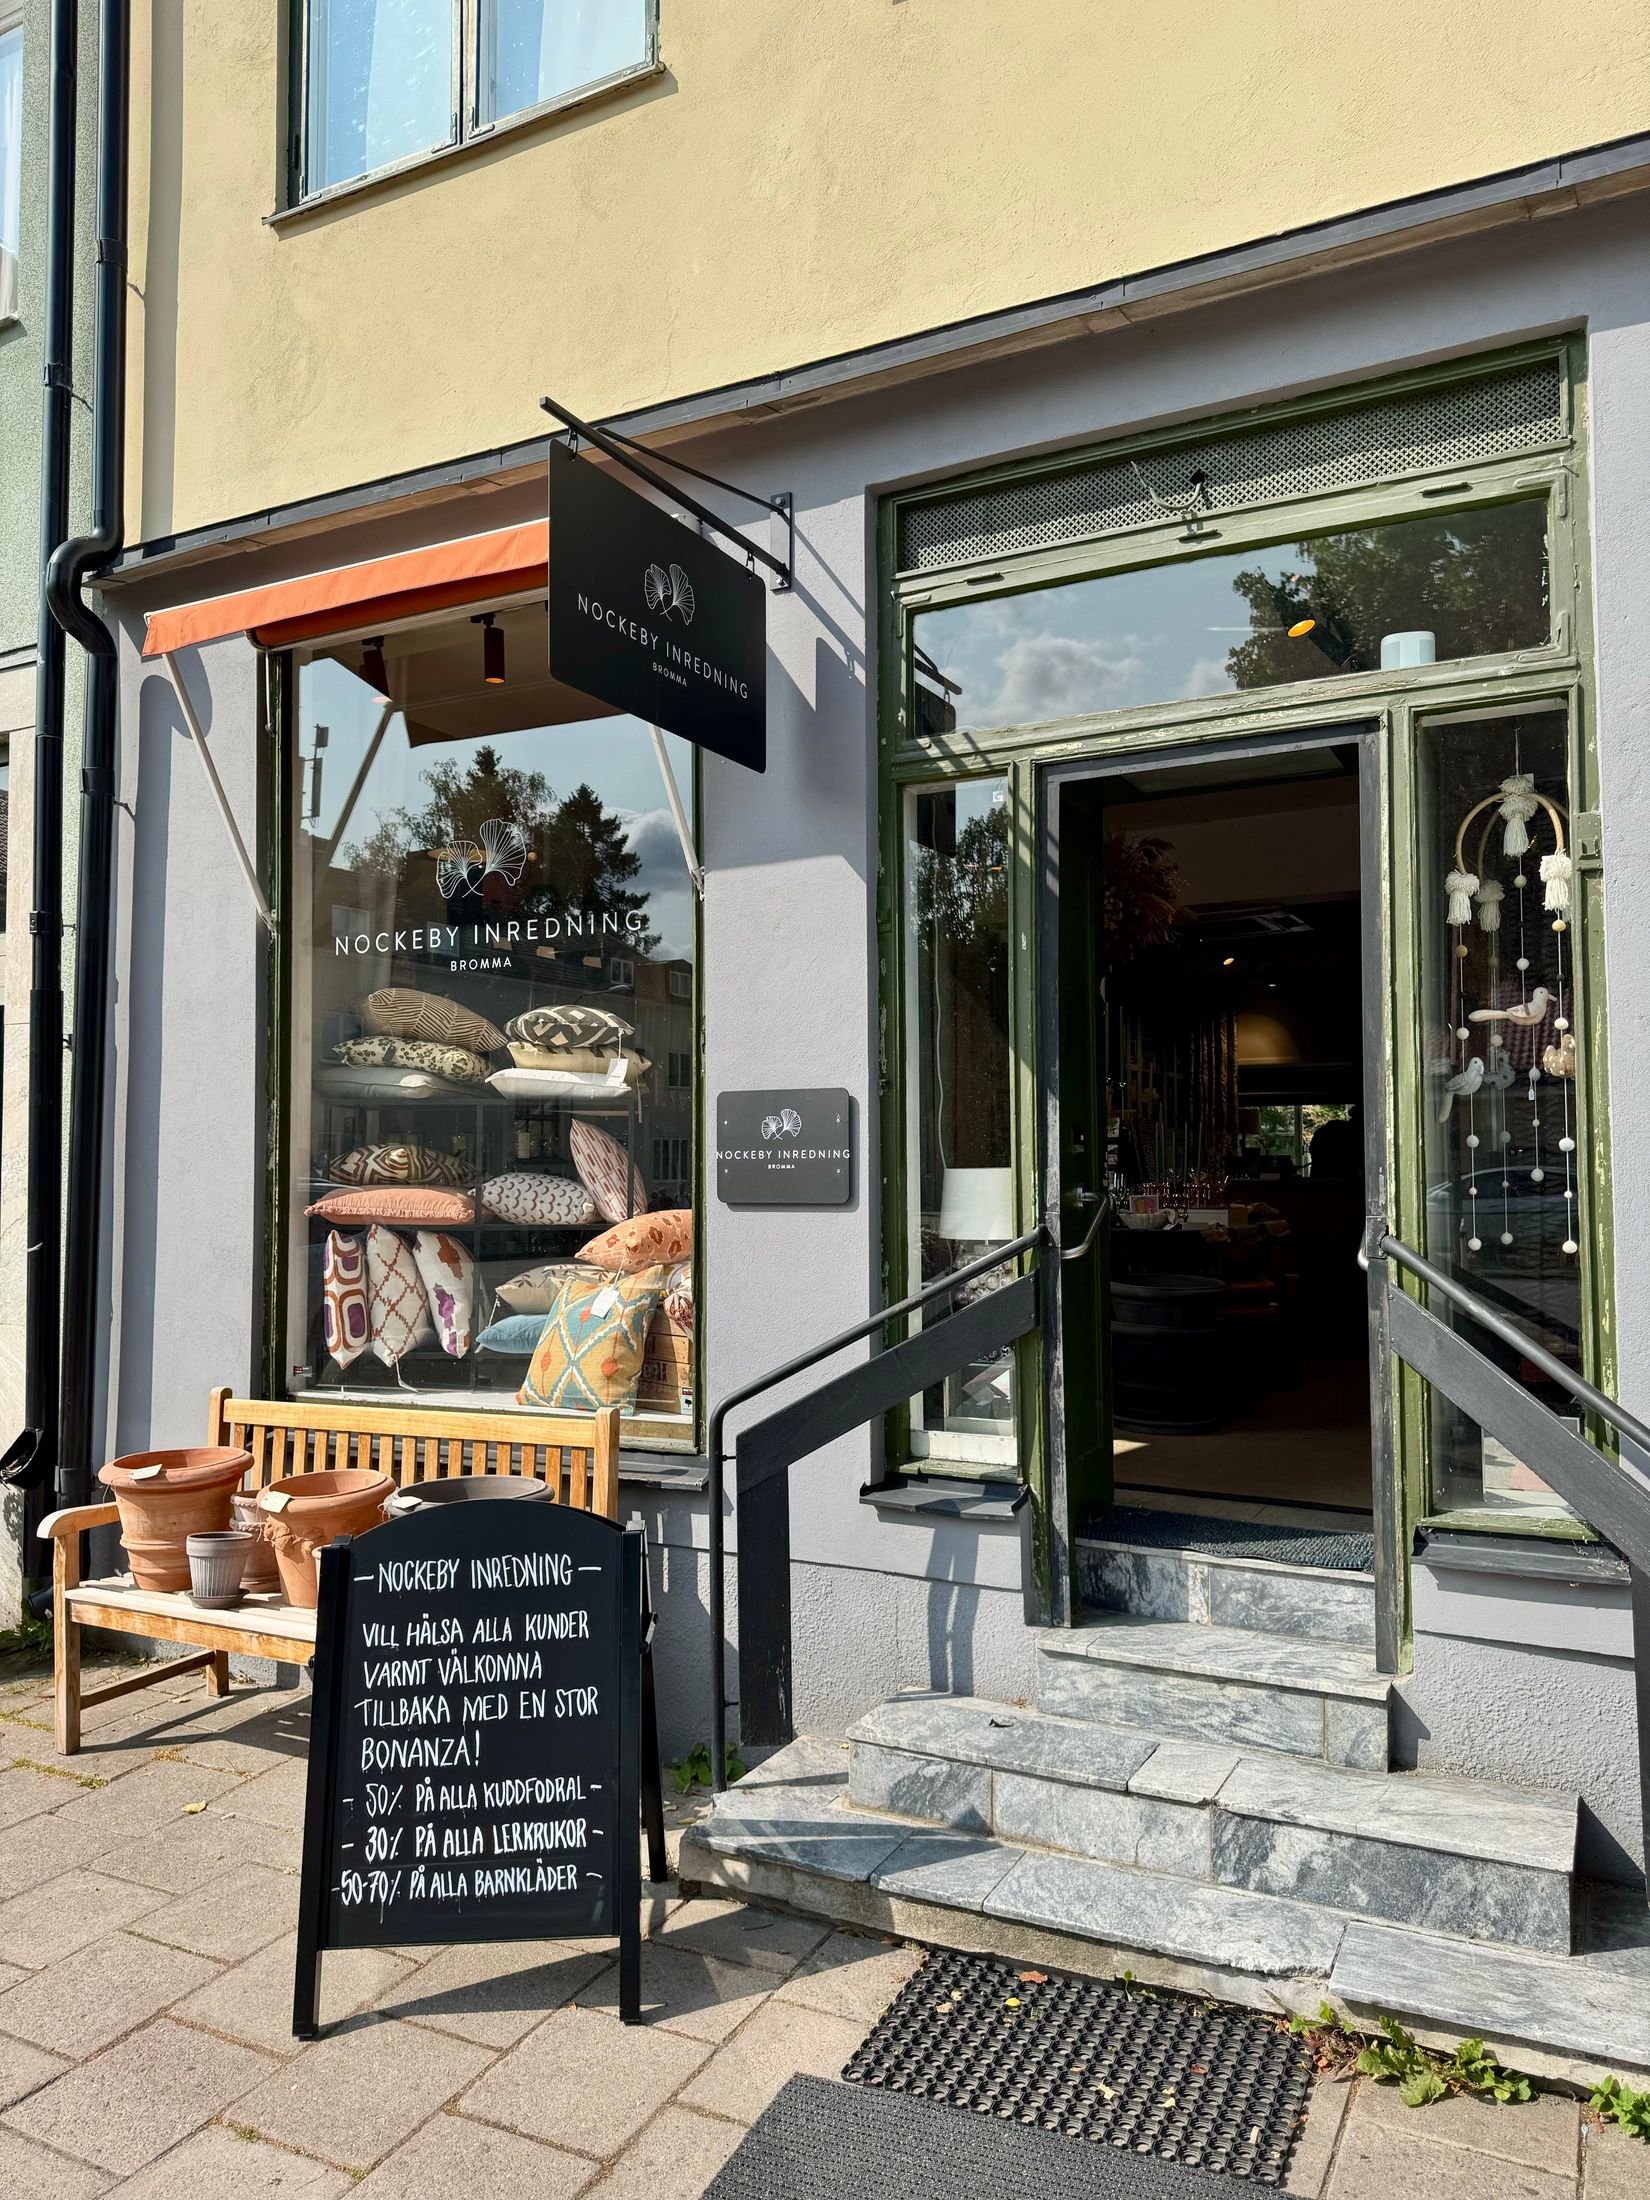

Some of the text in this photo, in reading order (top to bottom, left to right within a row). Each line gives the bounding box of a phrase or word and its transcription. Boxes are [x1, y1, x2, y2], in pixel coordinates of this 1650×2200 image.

[578, 593, 748, 699] NOCKEBY INREDNING
[653, 662, 687, 687] BROMMA
[334, 909, 643, 957] NOCKEBY INREDNING
[449, 956, 513, 972] BROMMA
[716, 1149, 850, 1159] NOCKEBY INREDNING
[378, 1552, 573, 1593] NOCKEBY INREDNING
[362, 1610, 590, 1648] VILL HÄLSA ALLA KUNDER
[363, 1648, 542, 1690] VARMT VÄLKOMNA
[353, 1686, 599, 1728] TILLBAKA MED EN STOR
[361, 1729, 480, 1771] BONANZA!
[365, 1775, 587, 1818] 50% PÅ ALLA KUDDFODRAL
[365, 1818, 587, 1864] 30% PÅ ALLA LERKRUKOR
[409, 1864, 426, 1900] PÅ
[429, 1870, 469, 1899] ALLA
[473, 1858, 578, 1898] BARNKLÄDER
